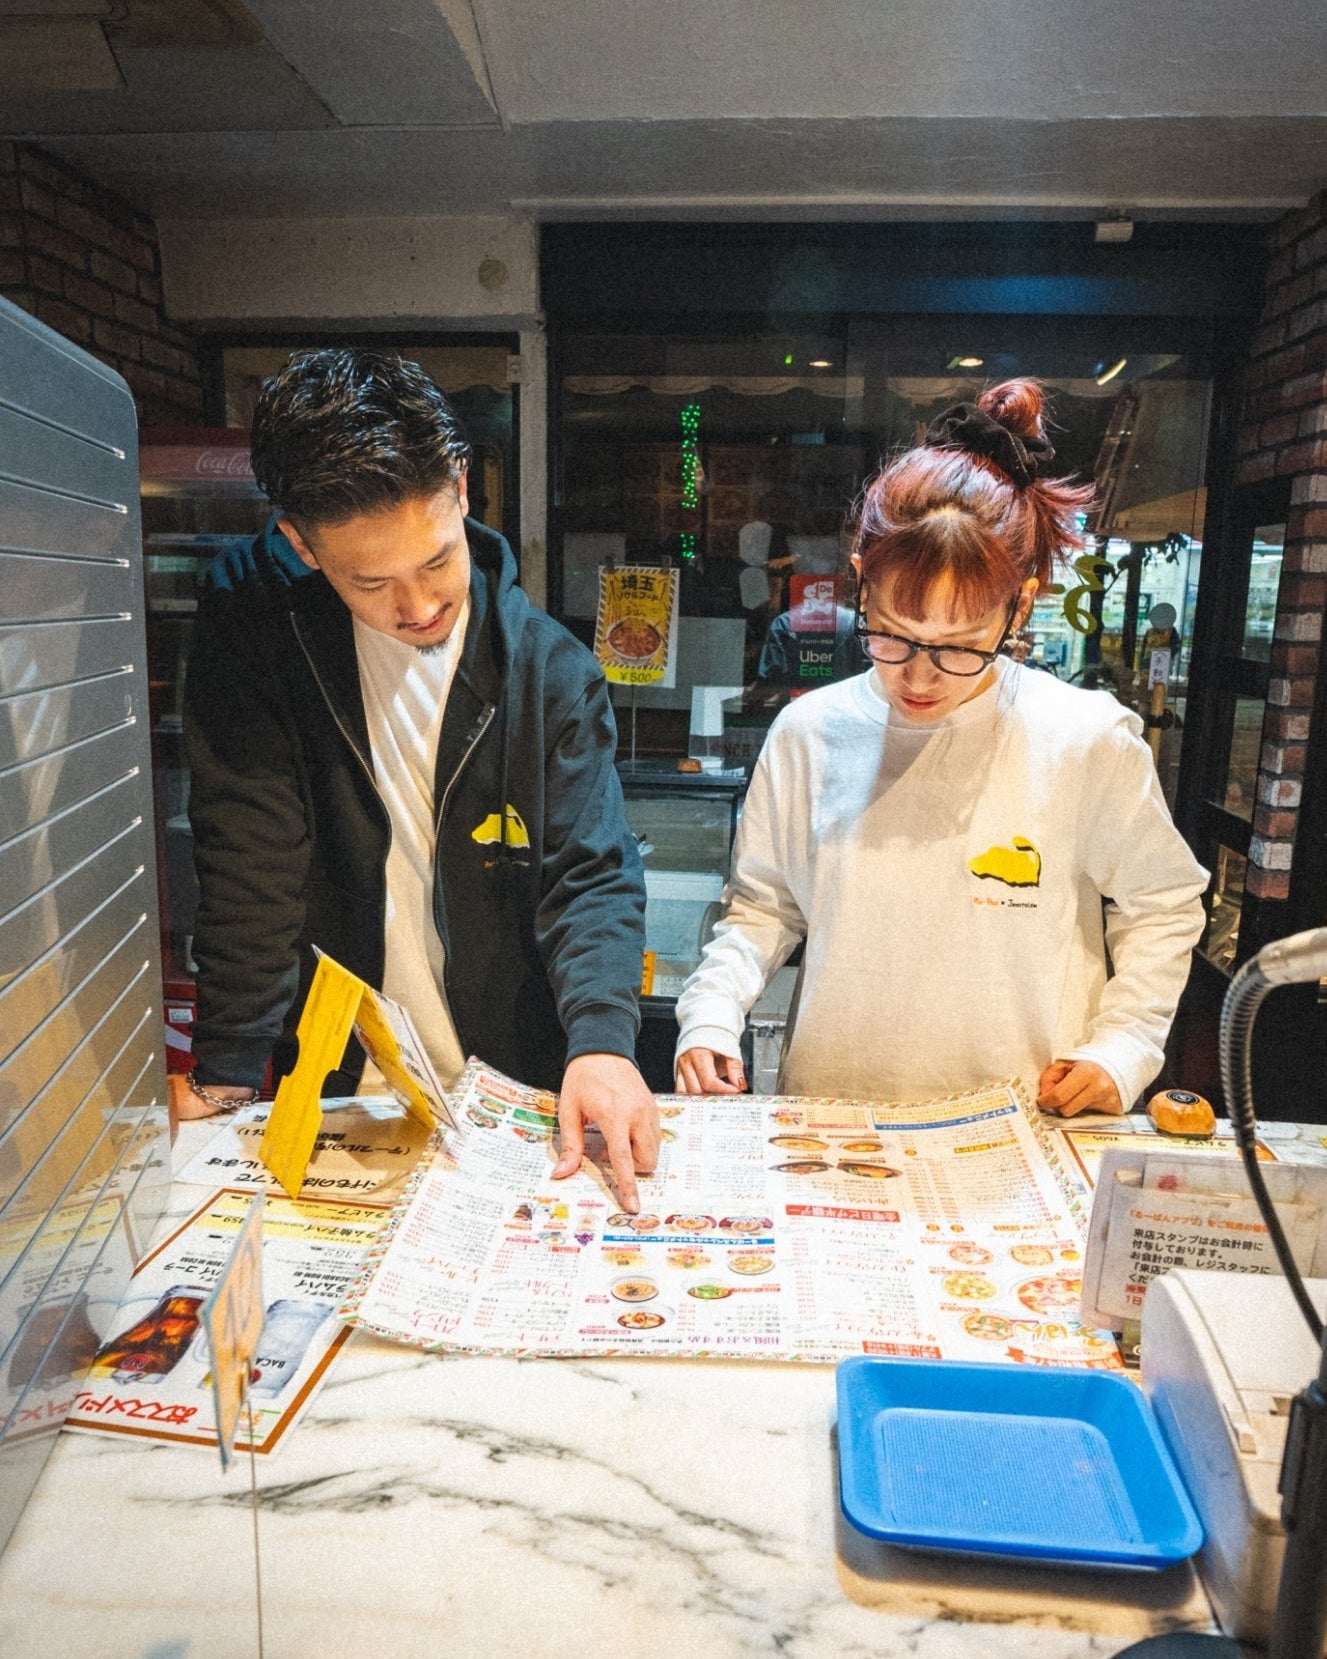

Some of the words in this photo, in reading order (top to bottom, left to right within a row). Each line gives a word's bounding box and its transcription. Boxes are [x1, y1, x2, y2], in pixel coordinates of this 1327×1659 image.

[621, 574, 656, 592] 埼玉
[800, 650, 834, 664] Uber
[800, 664, 833, 677] Eats
[204, 1157, 264, 1170] いします
[223, 1216, 245, 1224] 459
[327, 1208, 386, 1219] ラムビアー
[1133, 1228, 1264, 1251] 来店スタンプはお会計時に
[1131, 1239, 1223, 1259] 付与しております。
[162, 1262, 198, 1274] コーラ
[198, 1266, 223, 1277] ハイ
[322, 1273, 351, 1283] ACARDI
[1128, 1273, 1152, 1285] くだ
[294, 1279, 347, 1293] ラムハイ
[255, 1357, 286, 1369] BACA
[73, 1392, 198, 1427] おススメドリ
